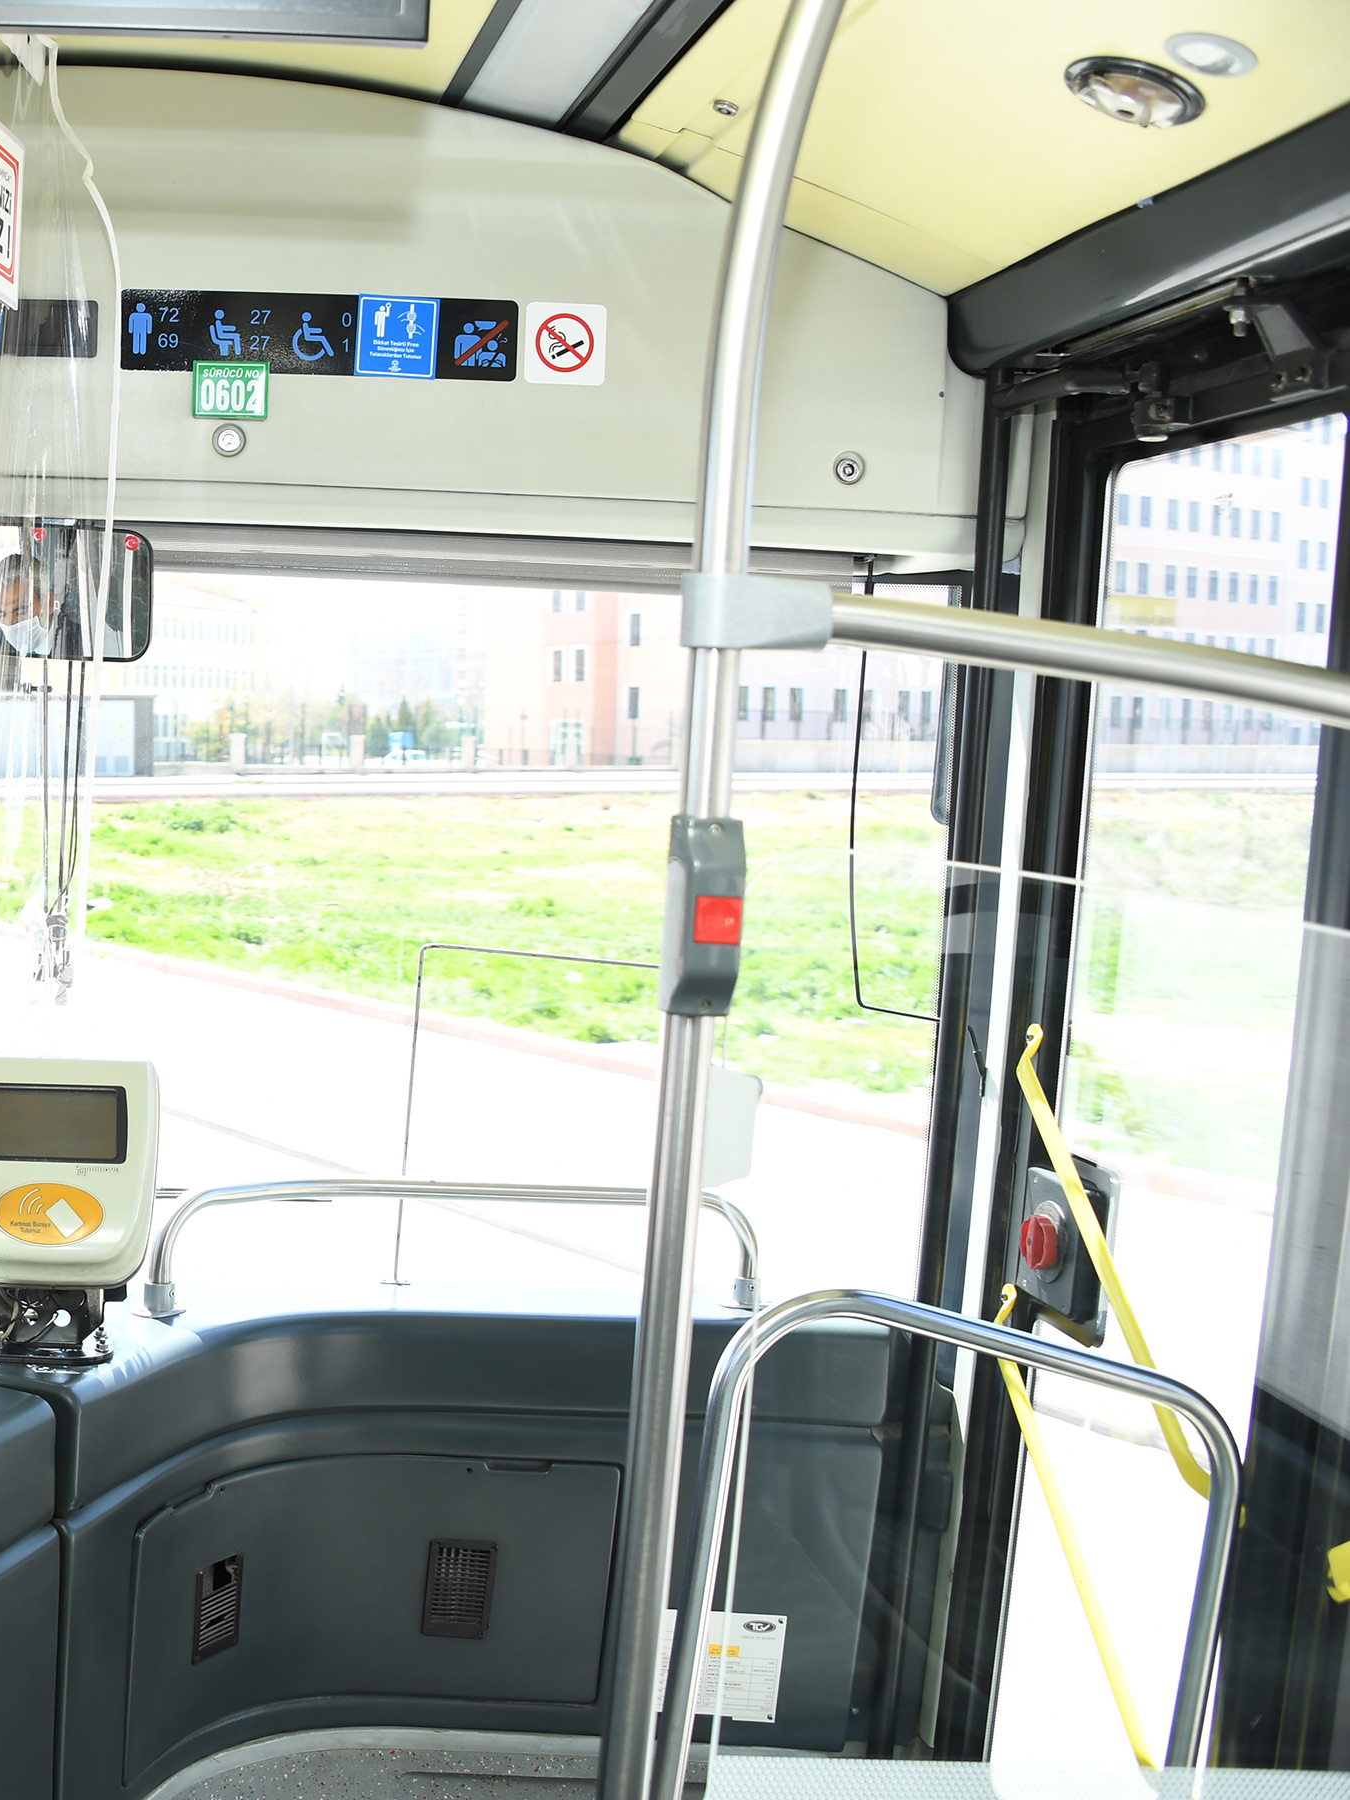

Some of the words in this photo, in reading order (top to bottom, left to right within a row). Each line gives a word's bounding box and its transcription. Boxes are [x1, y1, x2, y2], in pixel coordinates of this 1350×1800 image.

[158, 307, 180, 323] 72
[249, 309, 271, 325] 27
[157, 333, 179, 348] 69
[249, 335, 271, 351] 27
[202, 367, 244, 378] SÜRÜCÜ
[244, 369, 260, 379] NO
[200, 378, 261, 412] 0602
